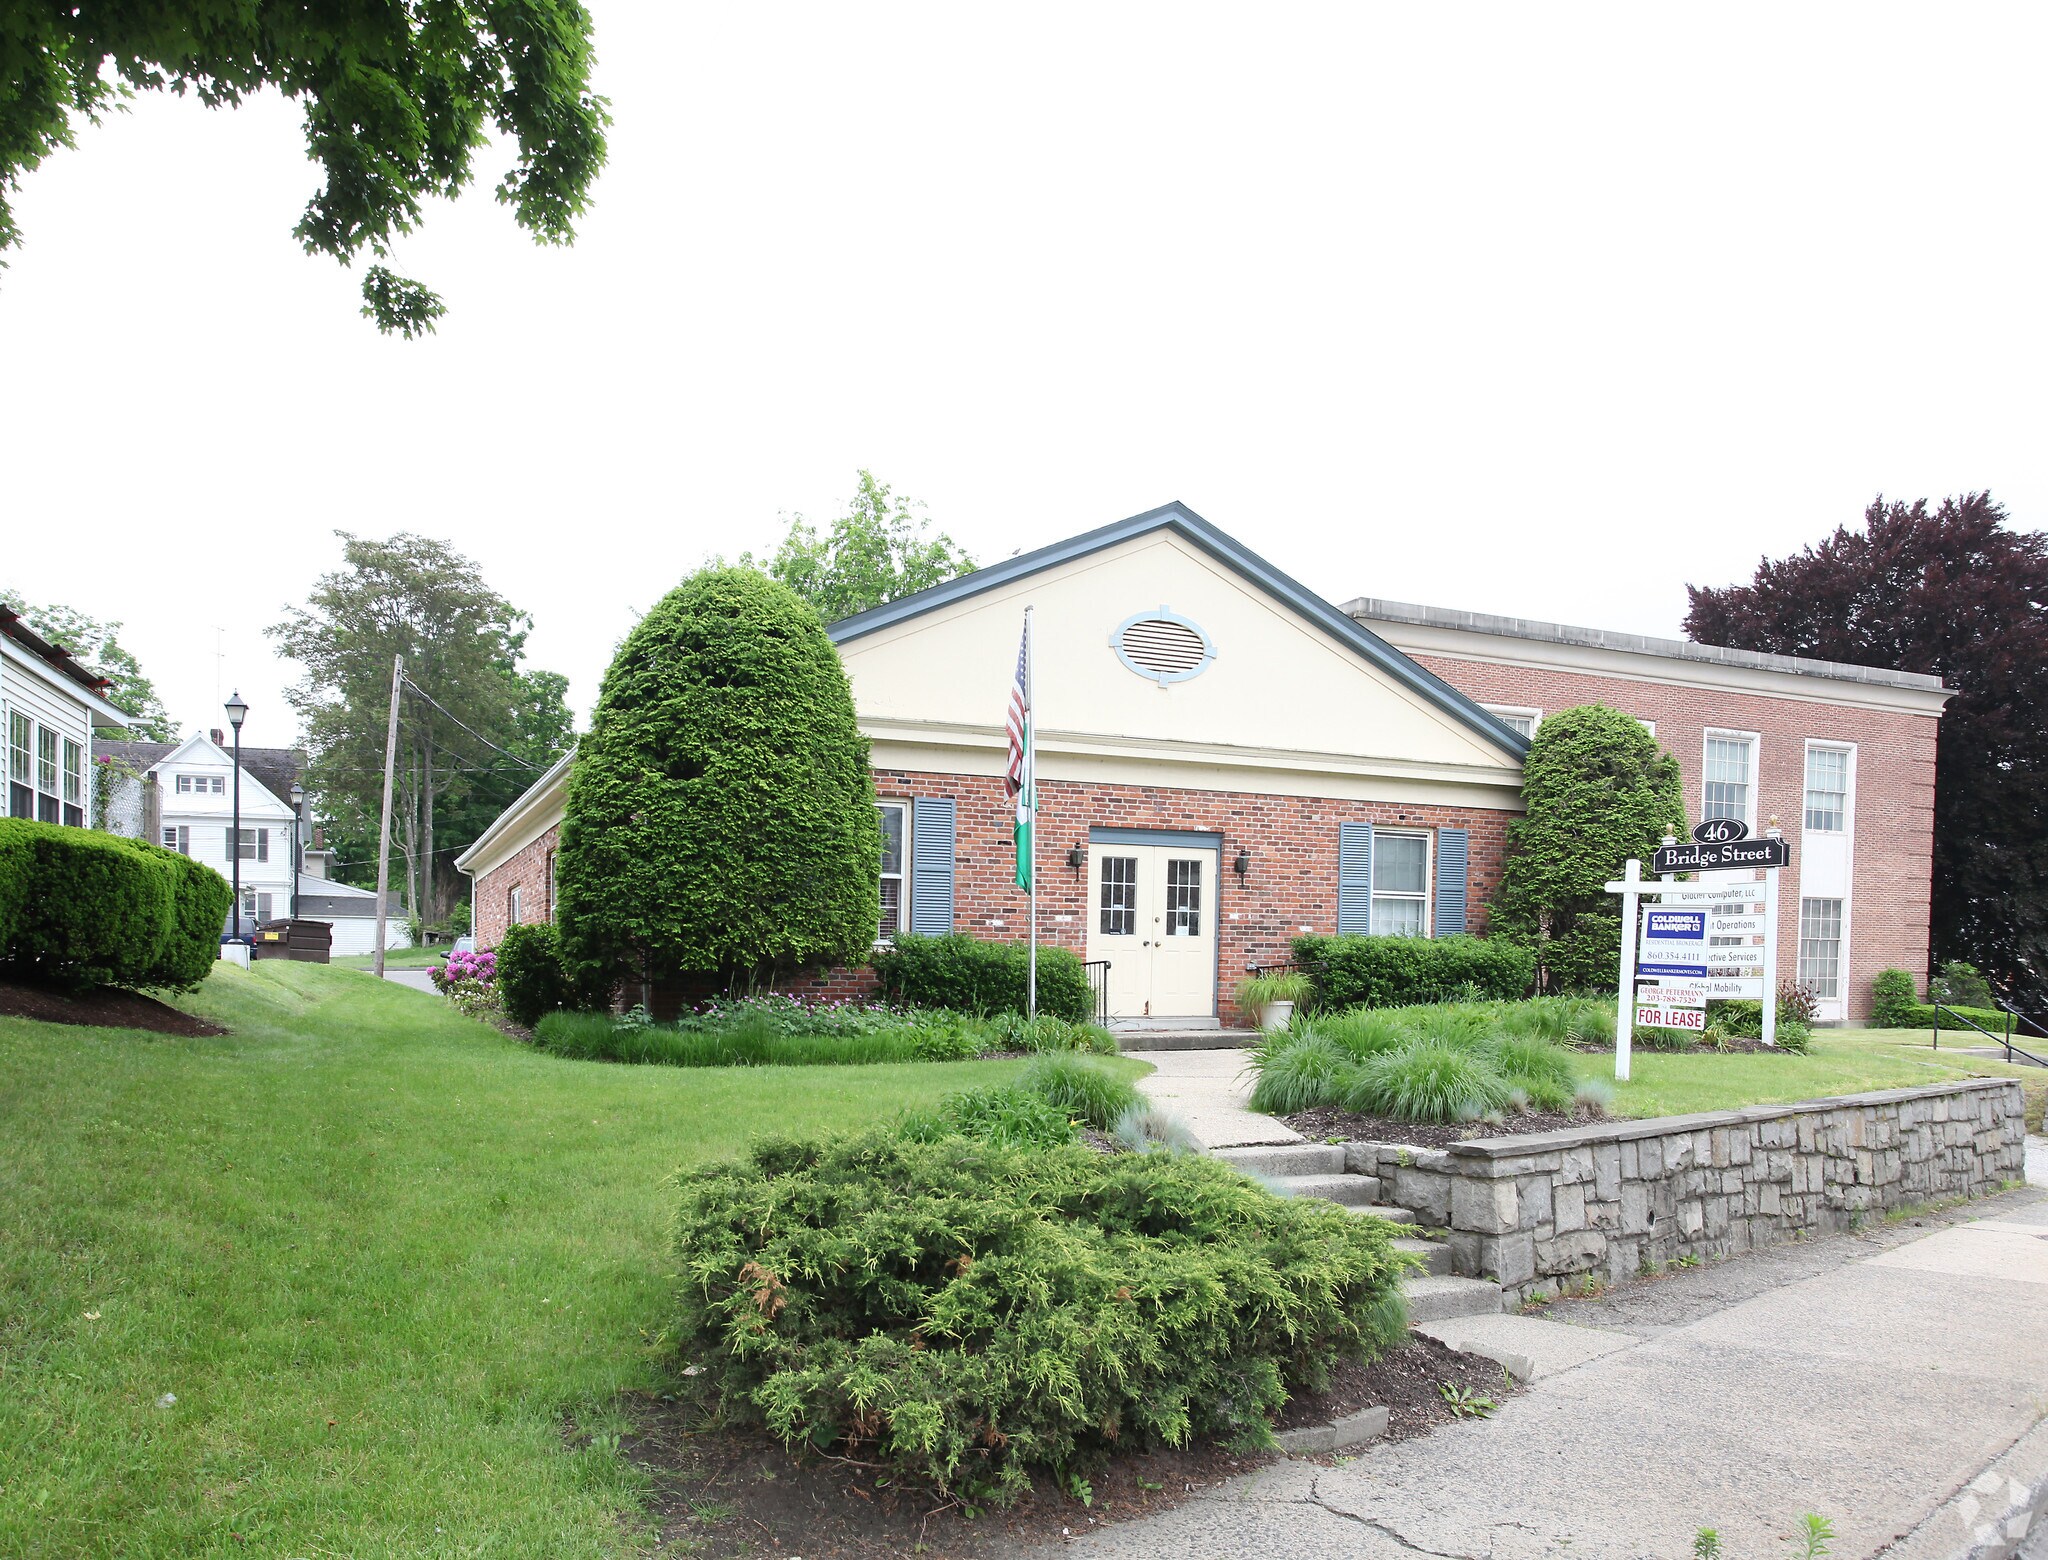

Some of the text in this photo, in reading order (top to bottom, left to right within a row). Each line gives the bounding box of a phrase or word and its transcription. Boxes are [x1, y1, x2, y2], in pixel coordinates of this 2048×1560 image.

[1704, 821, 1729, 841] 46
[1665, 845, 1772, 867] Bridge Street
[1745, 889, 1755, 897] LLC
[1651, 915, 1701, 923] COLDWELL
[1651, 923, 1692, 932] BANKER
[1716, 919, 1756, 931] Operations
[1647, 951, 1700, 960] 860.354.4111
[1728, 952, 1757, 962] Services
[1640, 987, 1704, 997] GEORGE PETERMANN
[1713, 982, 1742, 994] Mobility
[1638, 1009, 1702, 1027] FOR LEASE
